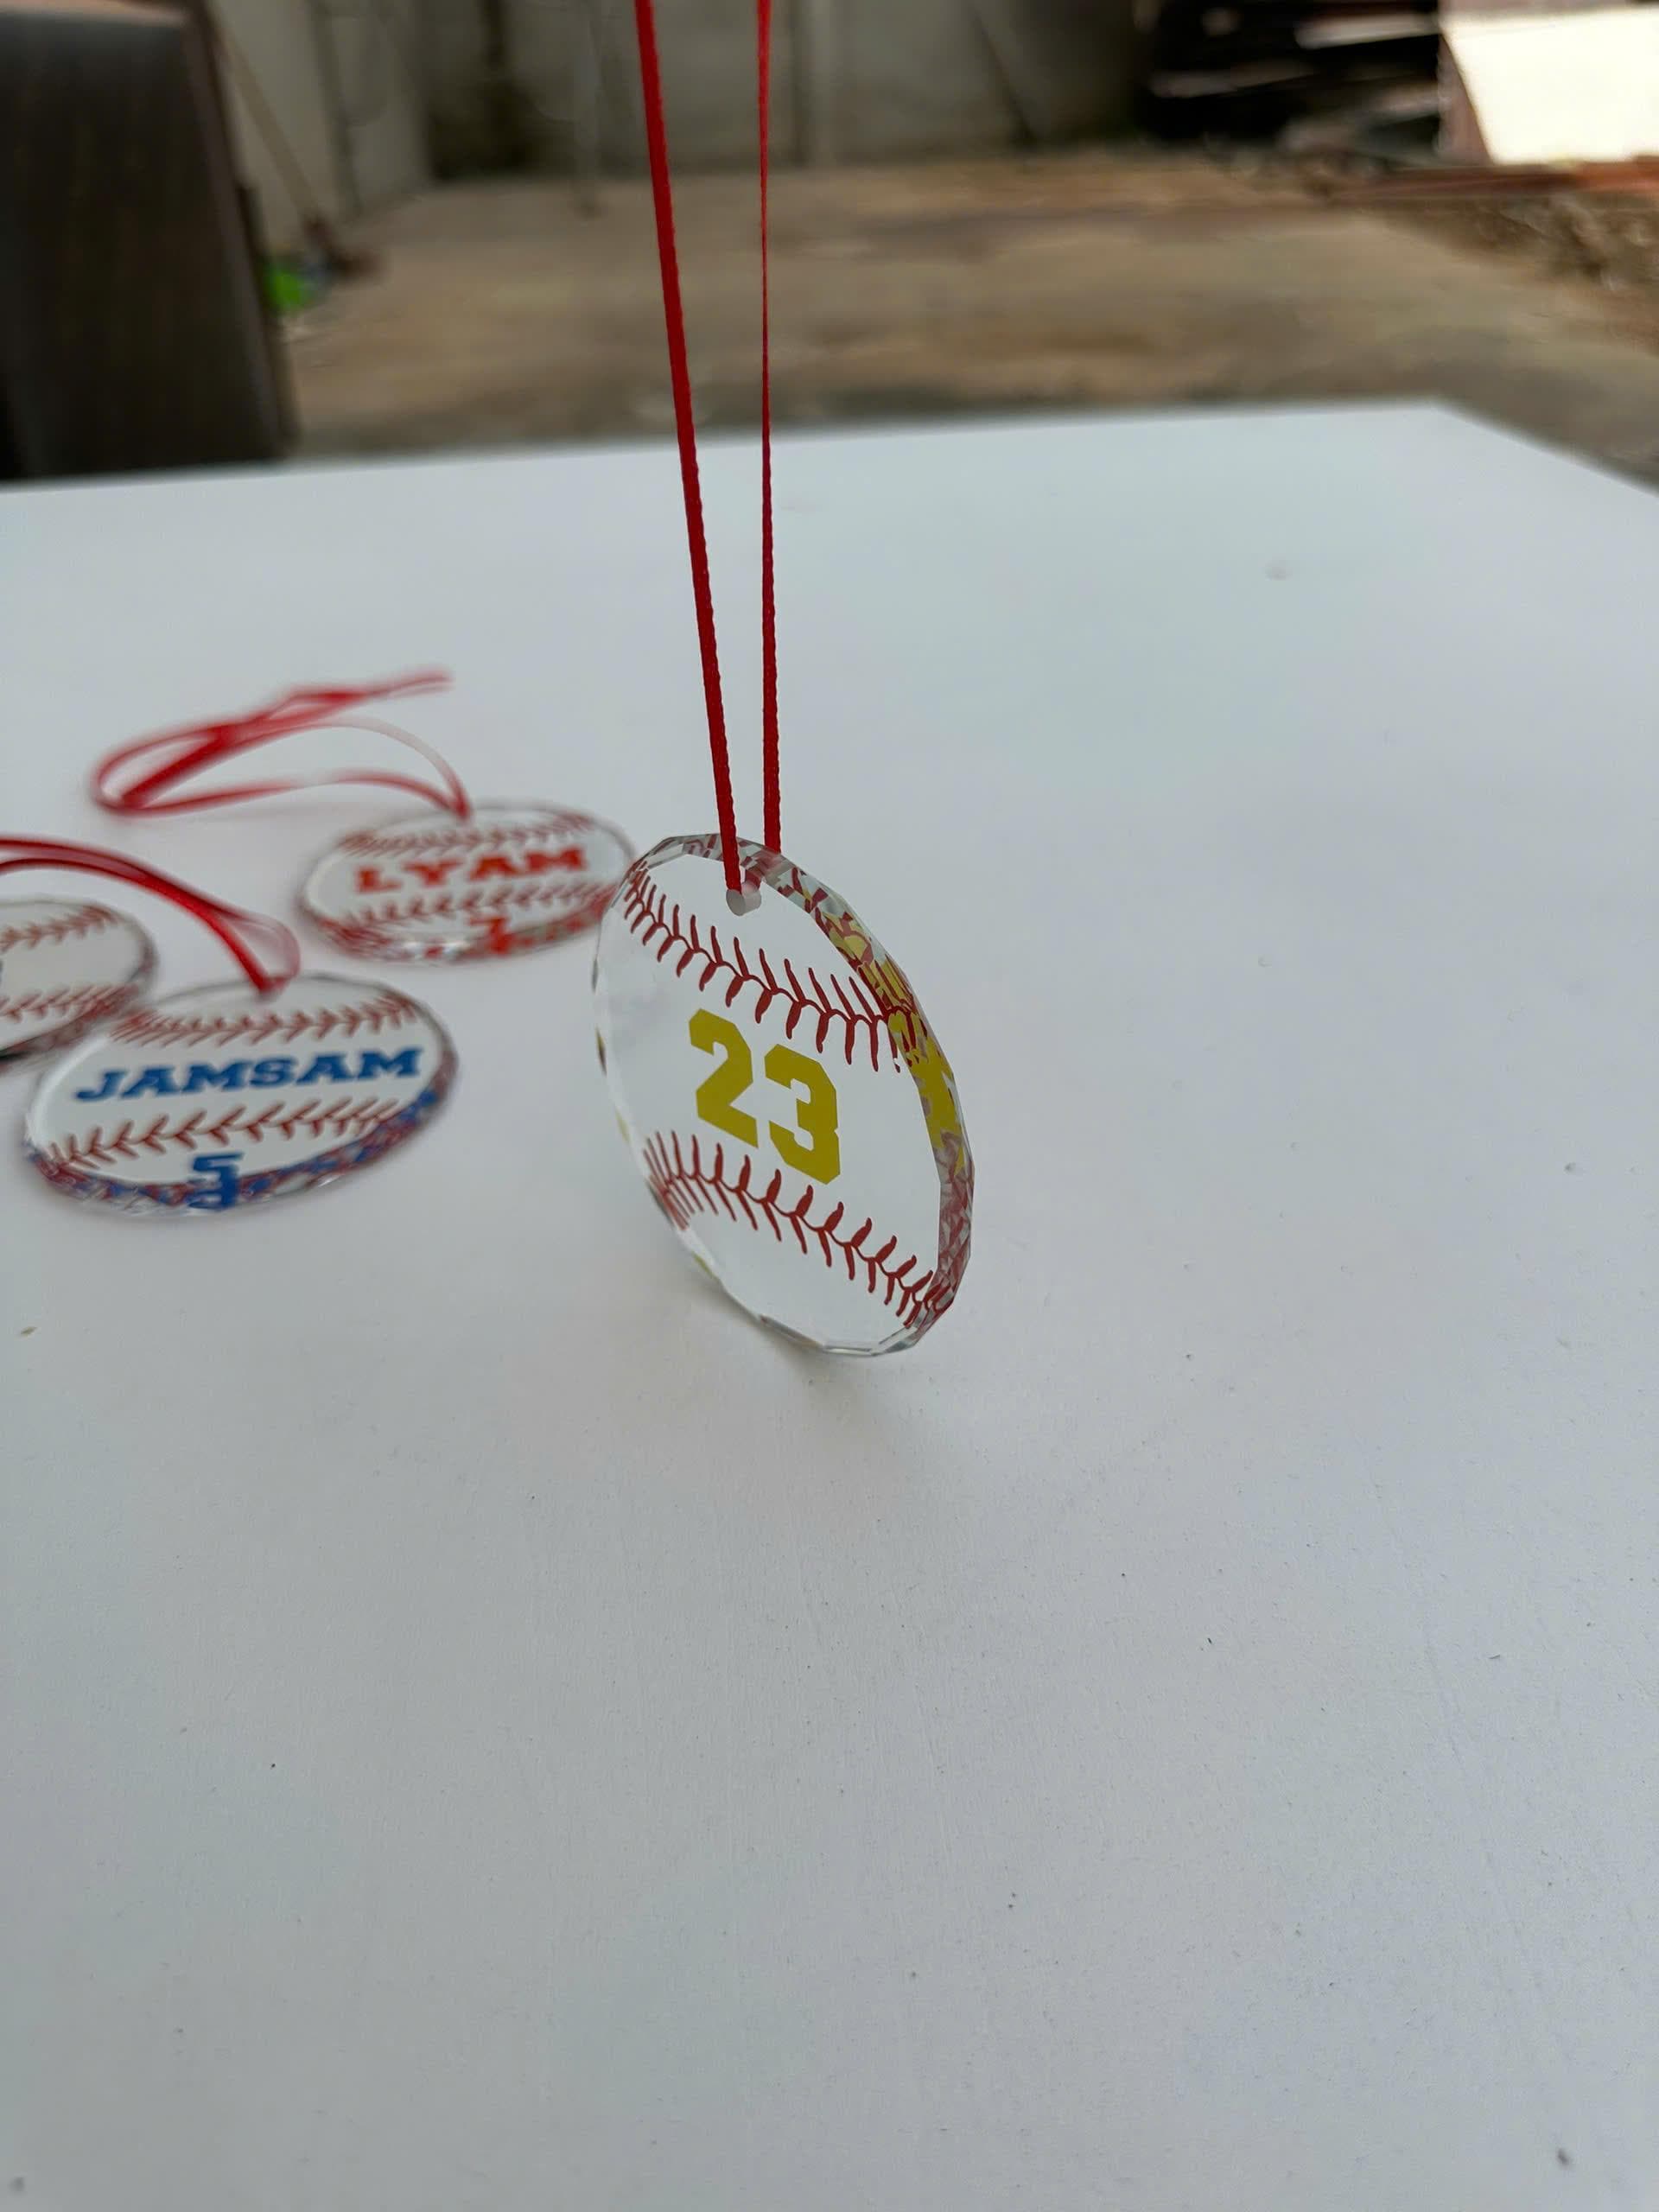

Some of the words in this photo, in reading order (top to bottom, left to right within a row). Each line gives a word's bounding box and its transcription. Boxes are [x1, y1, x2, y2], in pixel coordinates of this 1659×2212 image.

[354, 846, 588, 893] LYAM
[75, 1047, 423, 1102] JAMSAM
[689, 1008, 841, 1184] 23
[190, 1153, 243, 1207] 5
